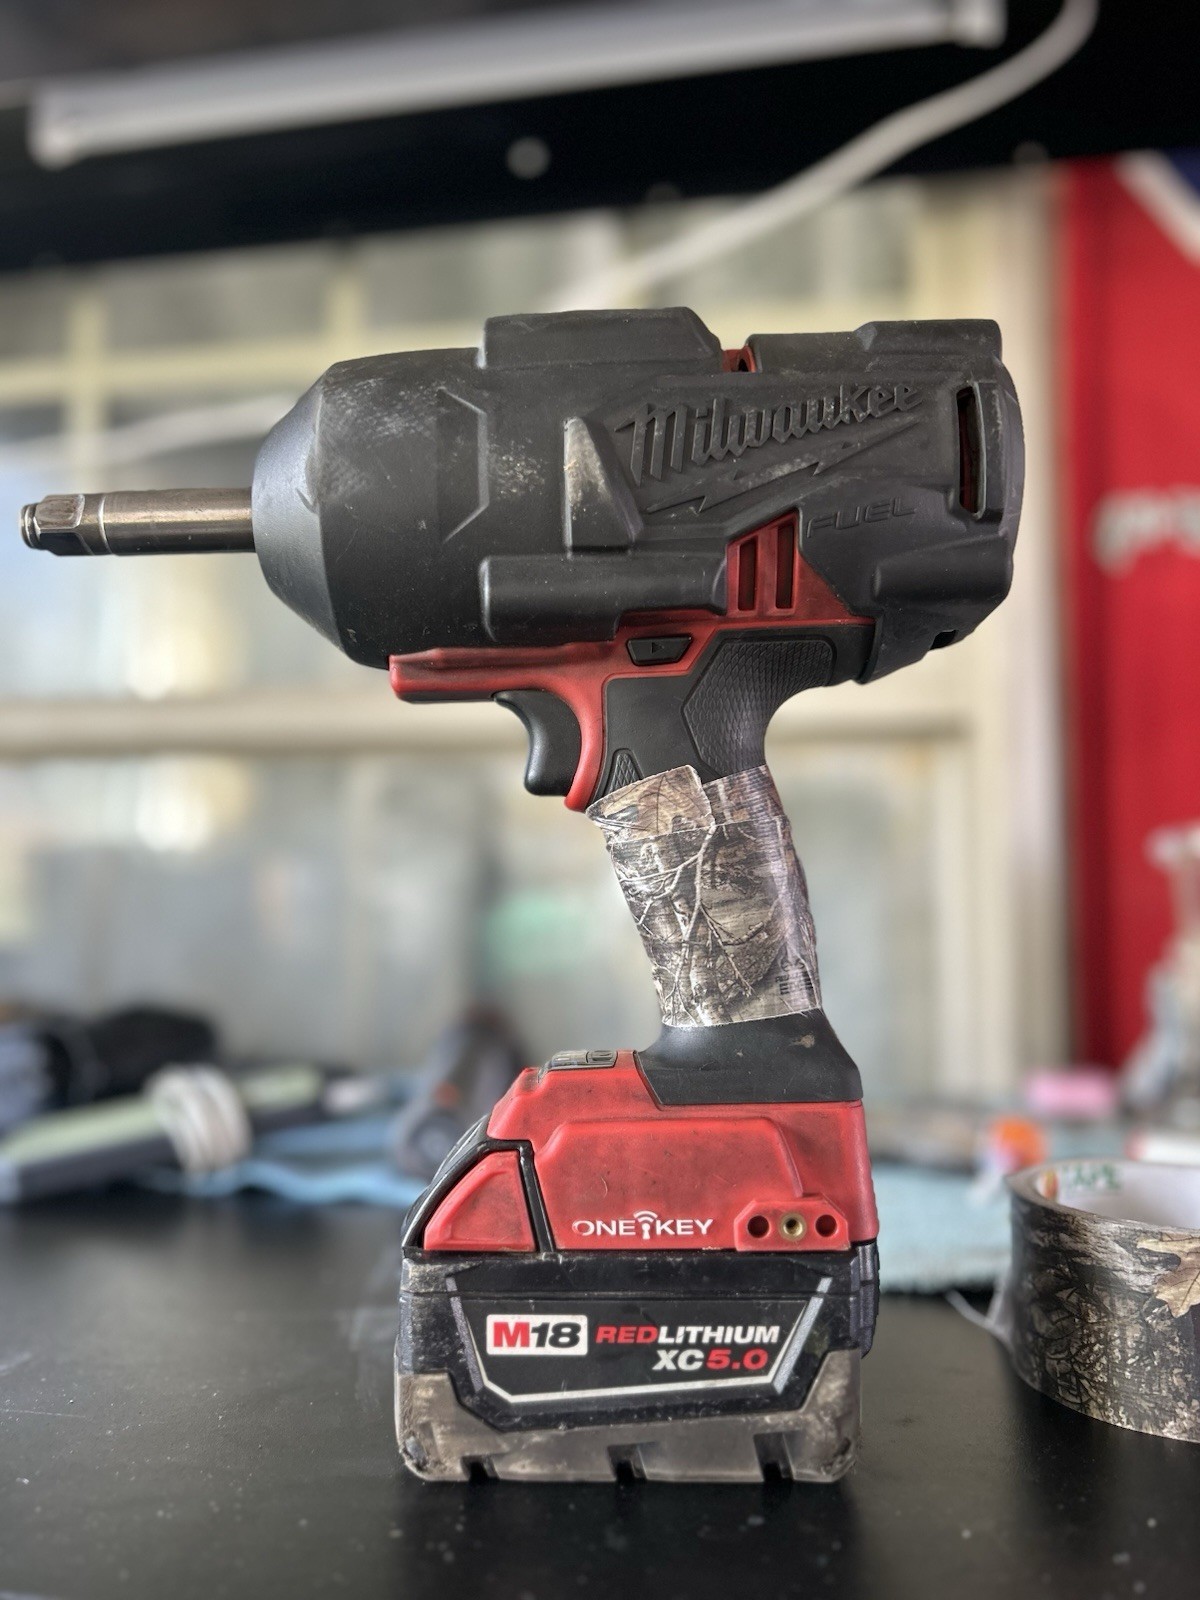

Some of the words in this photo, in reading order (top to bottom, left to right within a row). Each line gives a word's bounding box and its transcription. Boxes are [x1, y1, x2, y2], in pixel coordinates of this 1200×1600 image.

[614, 384, 922, 487] Milwaukee
[806, 498, 916, 539] FUEL
[493, 1321, 582, 1349] M18
[595, 1325, 780, 1345] REDLITHIUM
